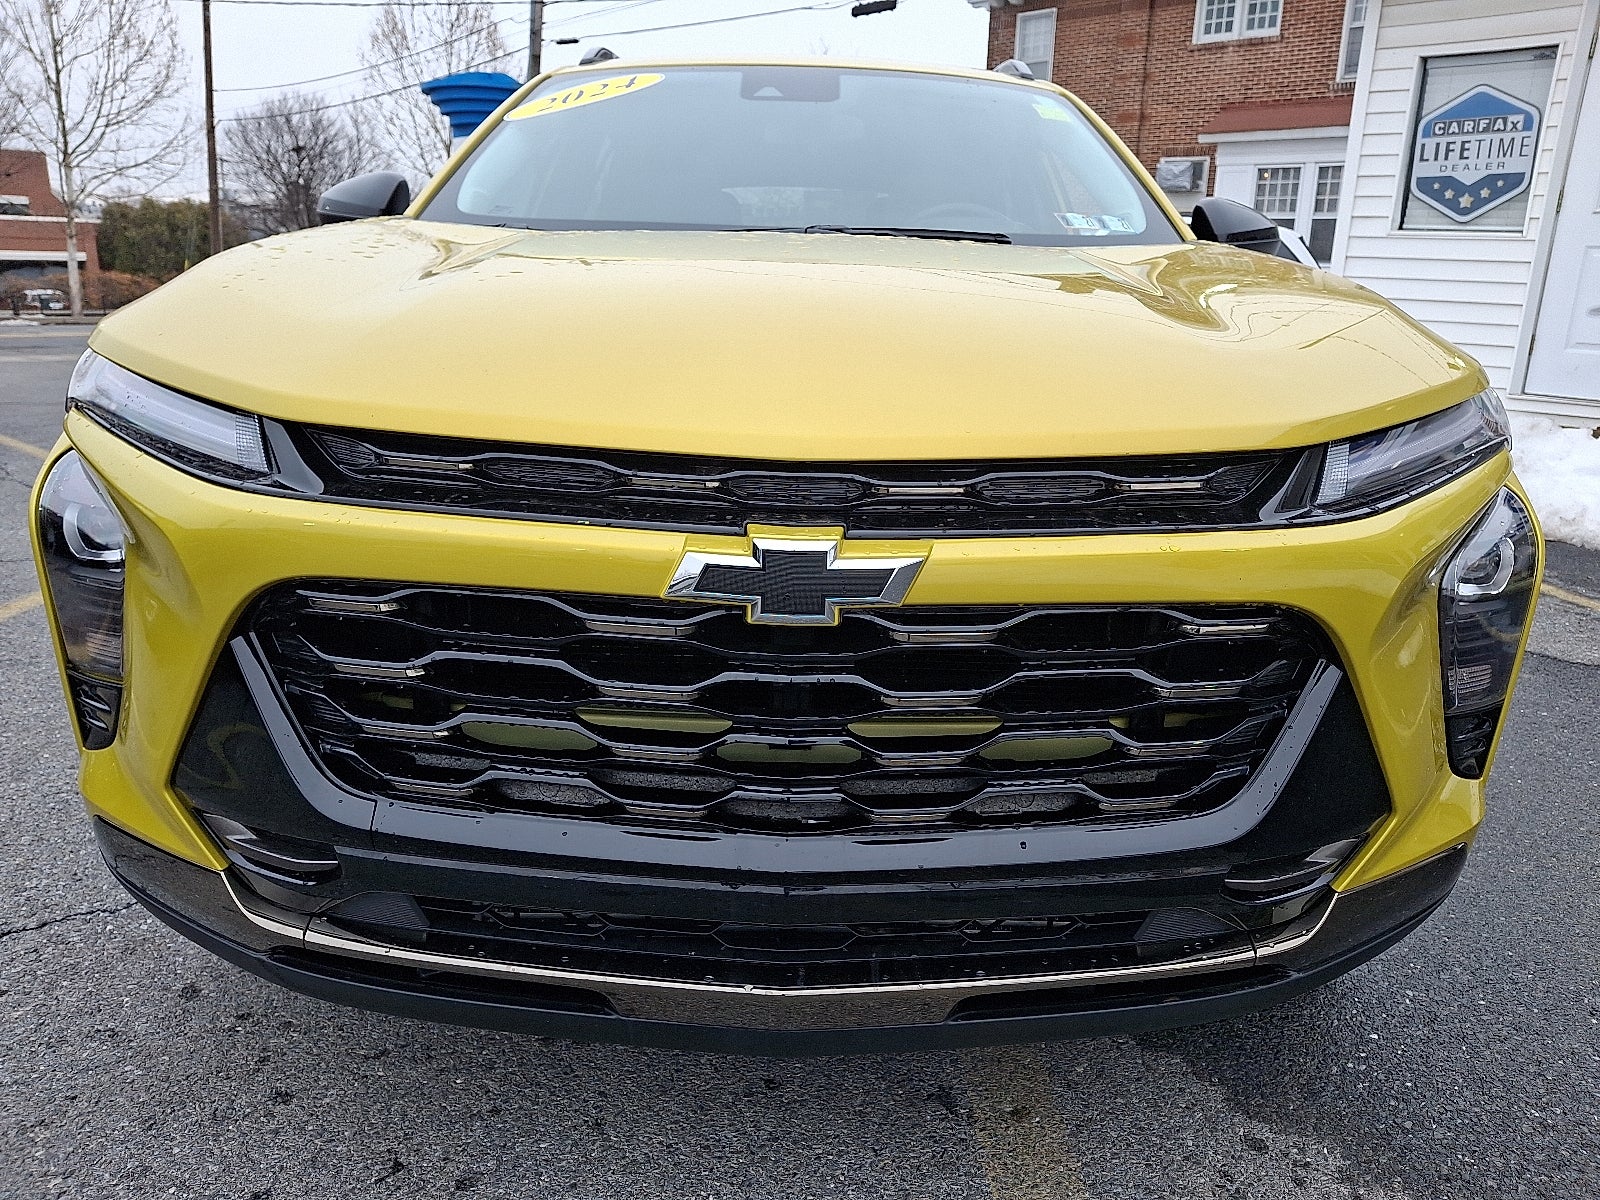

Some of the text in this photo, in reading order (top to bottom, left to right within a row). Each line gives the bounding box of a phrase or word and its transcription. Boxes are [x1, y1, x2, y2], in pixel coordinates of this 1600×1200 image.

[537, 75, 638, 113] 2024
[1433, 116, 1523, 136] CARFAX
[1419, 135, 1532, 163] LIFETIME
[1439, 162, 1506, 173] DEALER
